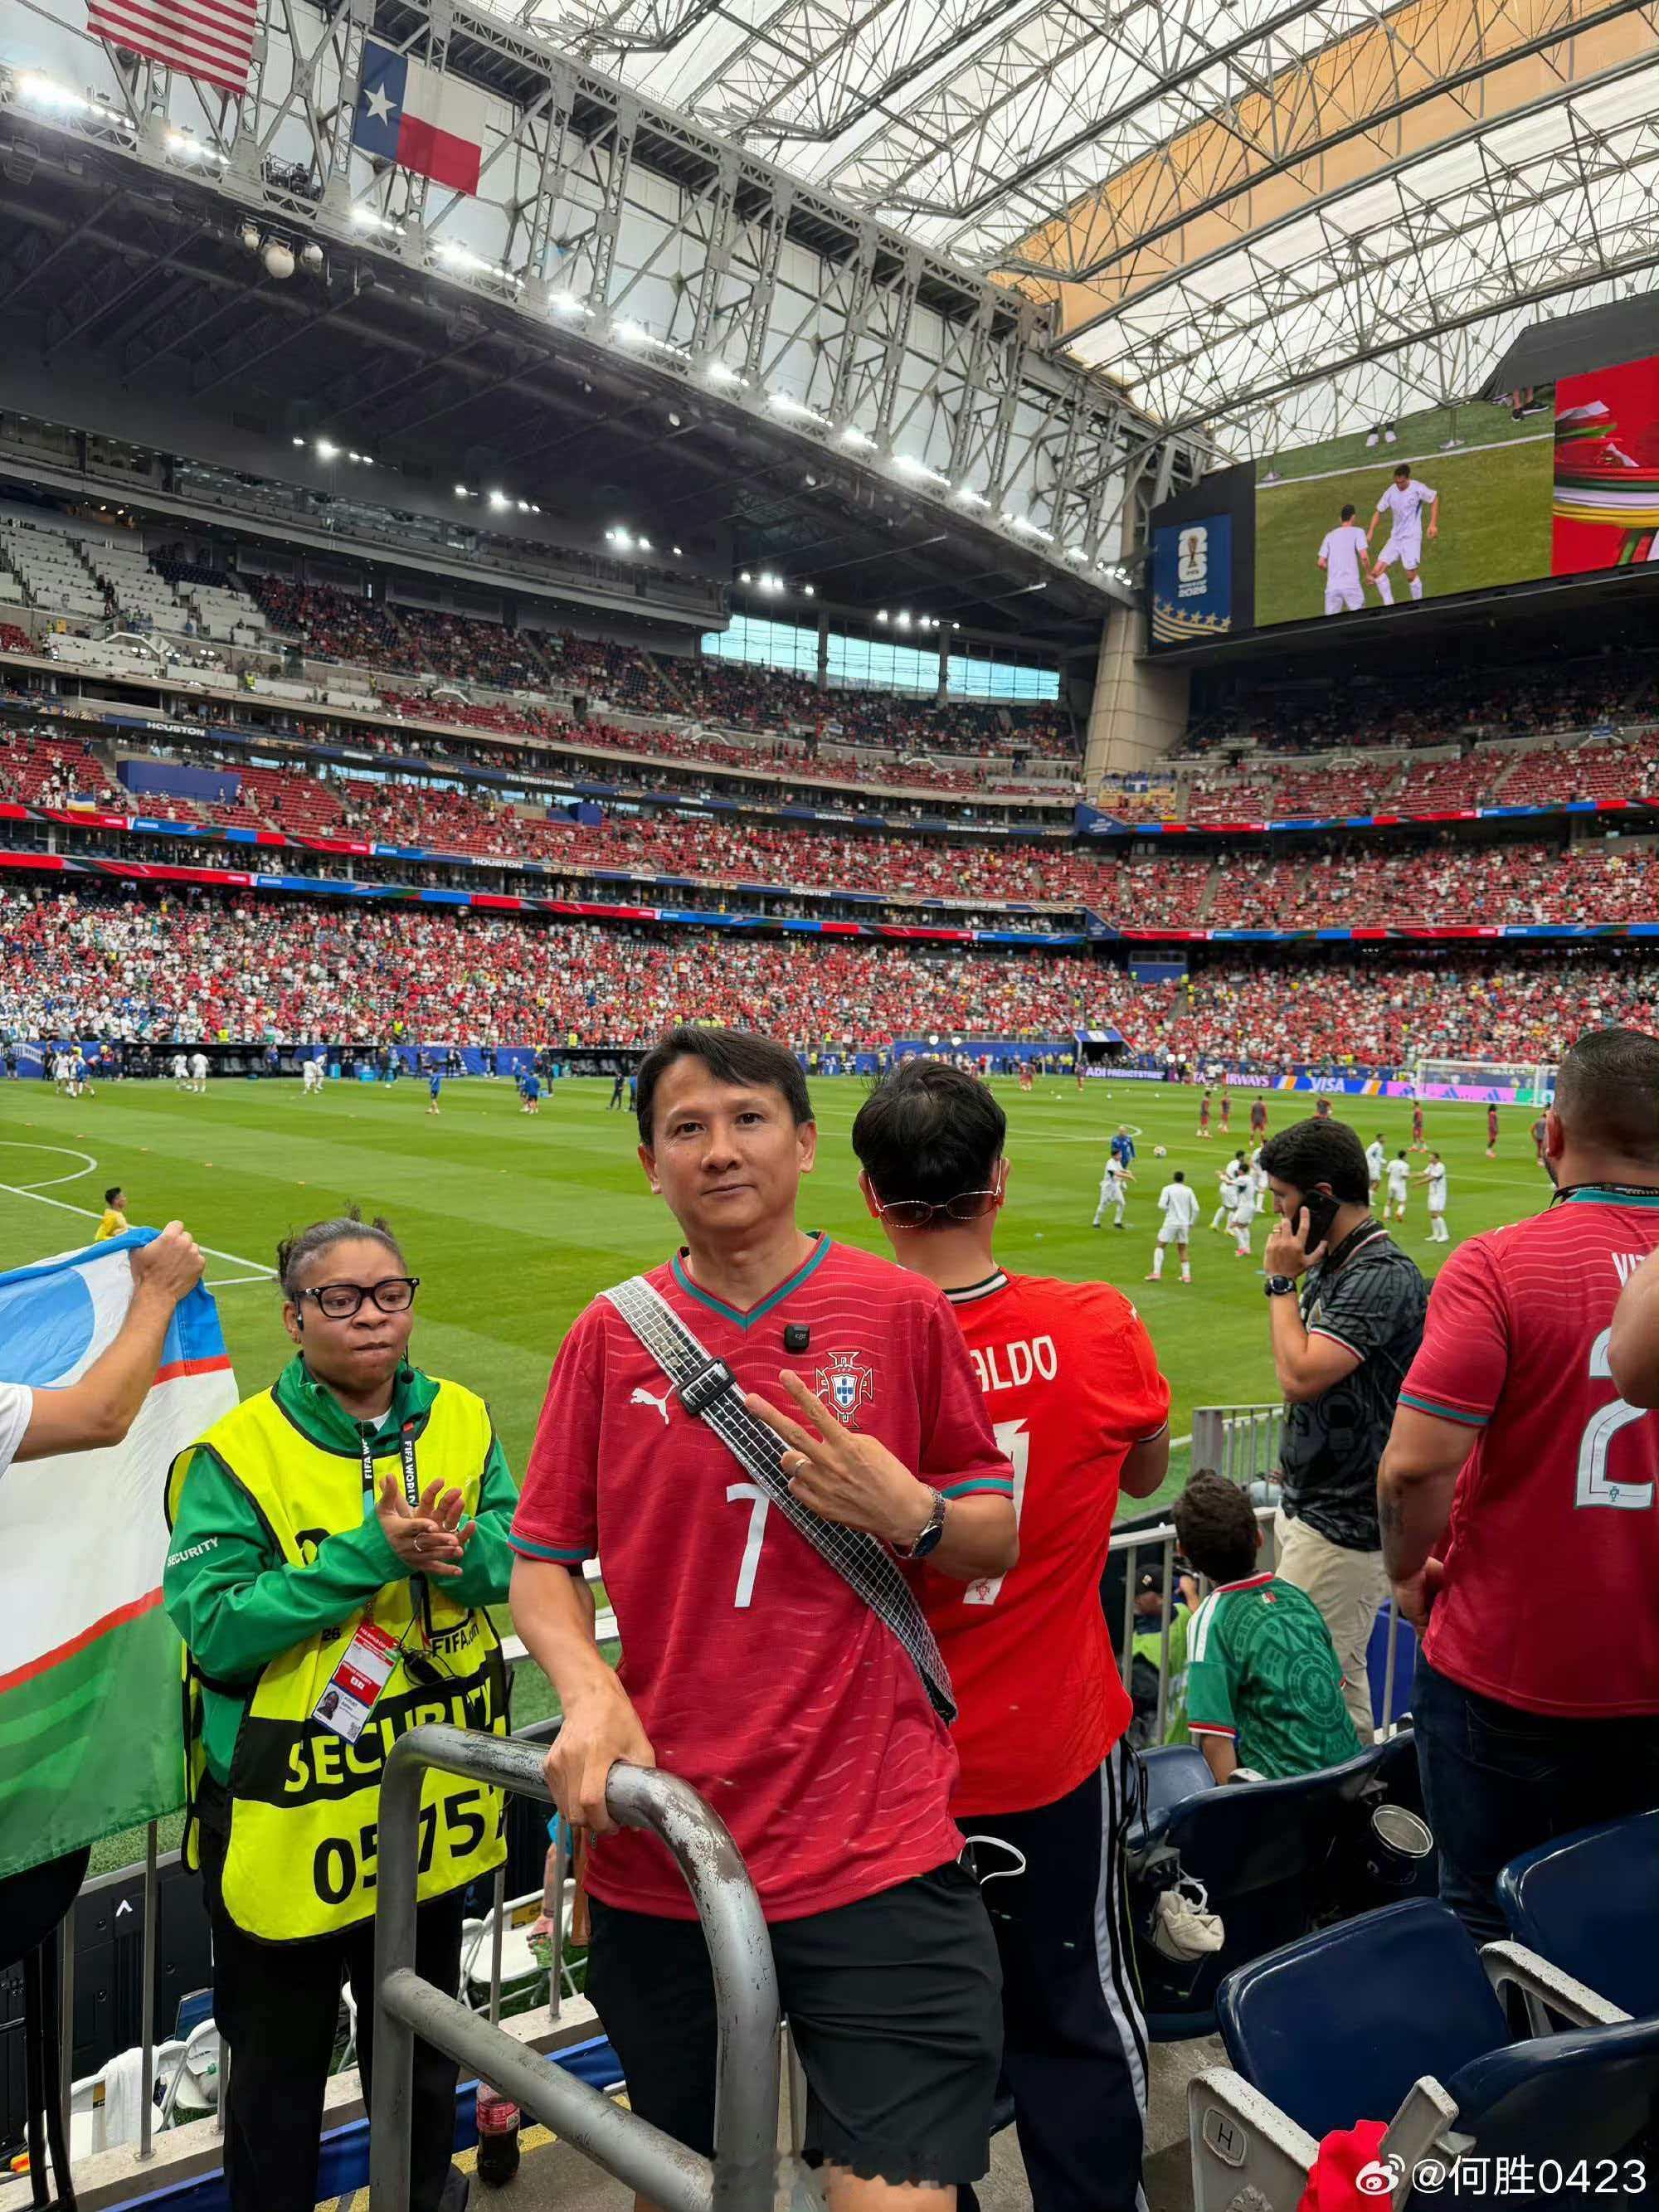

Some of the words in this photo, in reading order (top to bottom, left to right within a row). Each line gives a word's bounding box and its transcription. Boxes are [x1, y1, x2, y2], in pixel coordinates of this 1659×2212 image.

[146, 721, 206, 737] HOUSTON
[471, 858, 523, 869] HOUSTON
[790, 887, 830, 897] HOUSTON
[1227, 1072, 1271, 1087] IRWAYS
[1308, 1077, 1345, 1093] VISA
[969, 1334, 1058, 1393] ALDO
[404, 1440, 413, 1463] FIFA
[362, 1456, 372, 1479] FIFA
[167, 1536, 218, 1568] SECURITY
[726, 1482, 771, 1608] 7
[1216, 2122, 1233, 2151] H
